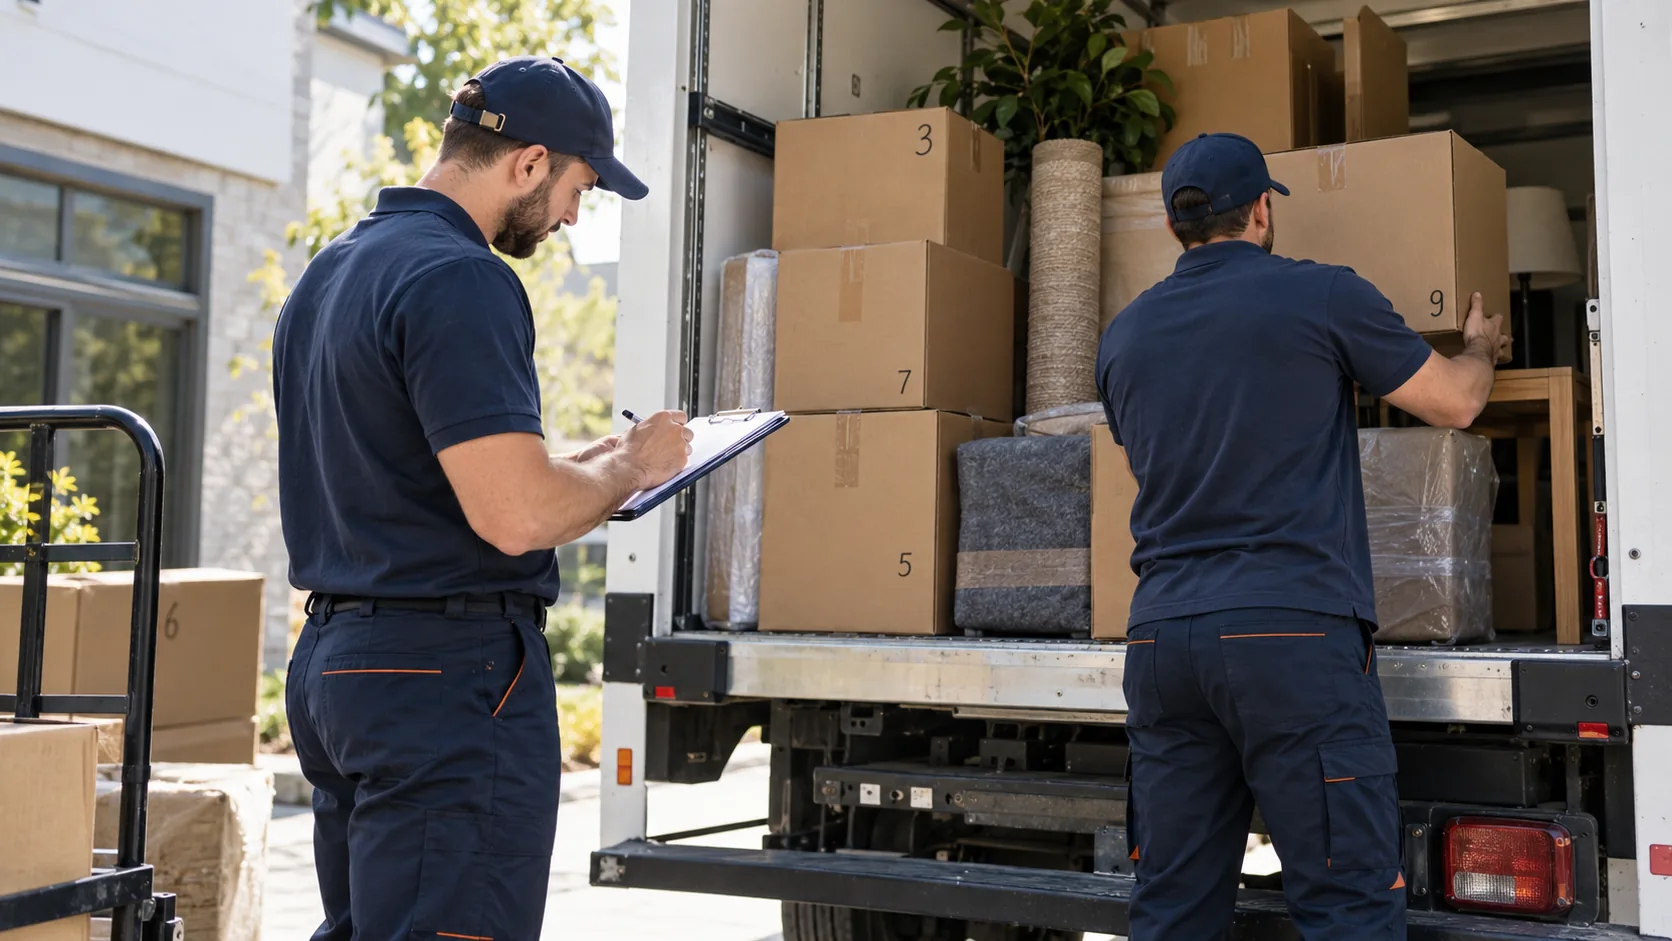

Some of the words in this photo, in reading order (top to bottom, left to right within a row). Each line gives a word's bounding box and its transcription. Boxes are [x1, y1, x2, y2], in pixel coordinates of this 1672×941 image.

[916, 123, 932, 157] 3
[1429, 289, 1444, 318] 9
[898, 369, 912, 395] 7
[898, 552, 912, 578] 5
[165, 601, 180, 640] 6
